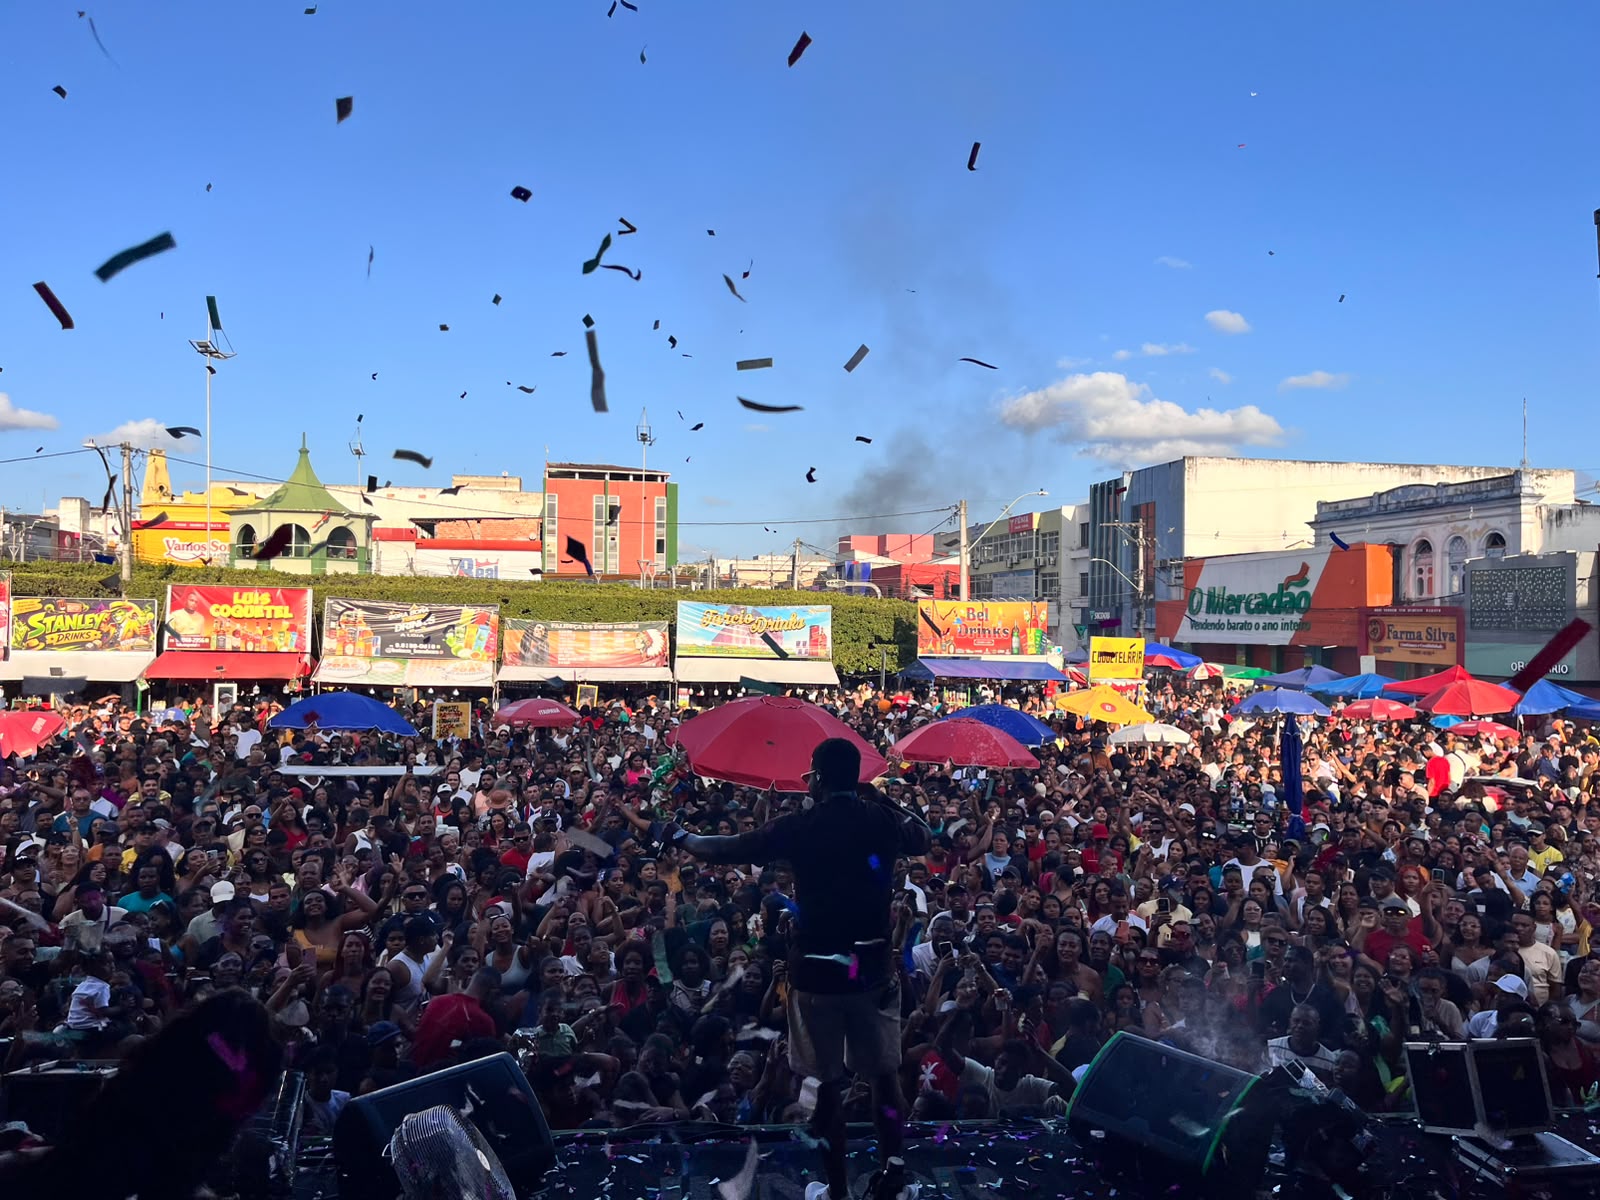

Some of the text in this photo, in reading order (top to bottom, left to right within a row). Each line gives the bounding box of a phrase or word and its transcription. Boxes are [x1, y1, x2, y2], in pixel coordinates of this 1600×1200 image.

[165, 539, 207, 552] Vamos
[232, 591, 272, 605] LUIS
[1188, 577, 1312, 616] O Mercadão
[209, 603, 294, 619] COQUETEL
[966, 607, 989, 622] Bel
[27, 612, 105, 640] STANLEY
[750, 613, 806, 634] Drinks
[957, 623, 1010, 639] Drinks
[1190, 618, 1311, 631] Vendendo barato o ano inteiro
[56, 631, 92, 643] DRINKS
[1386, 624, 1457, 642] Farma Silva
